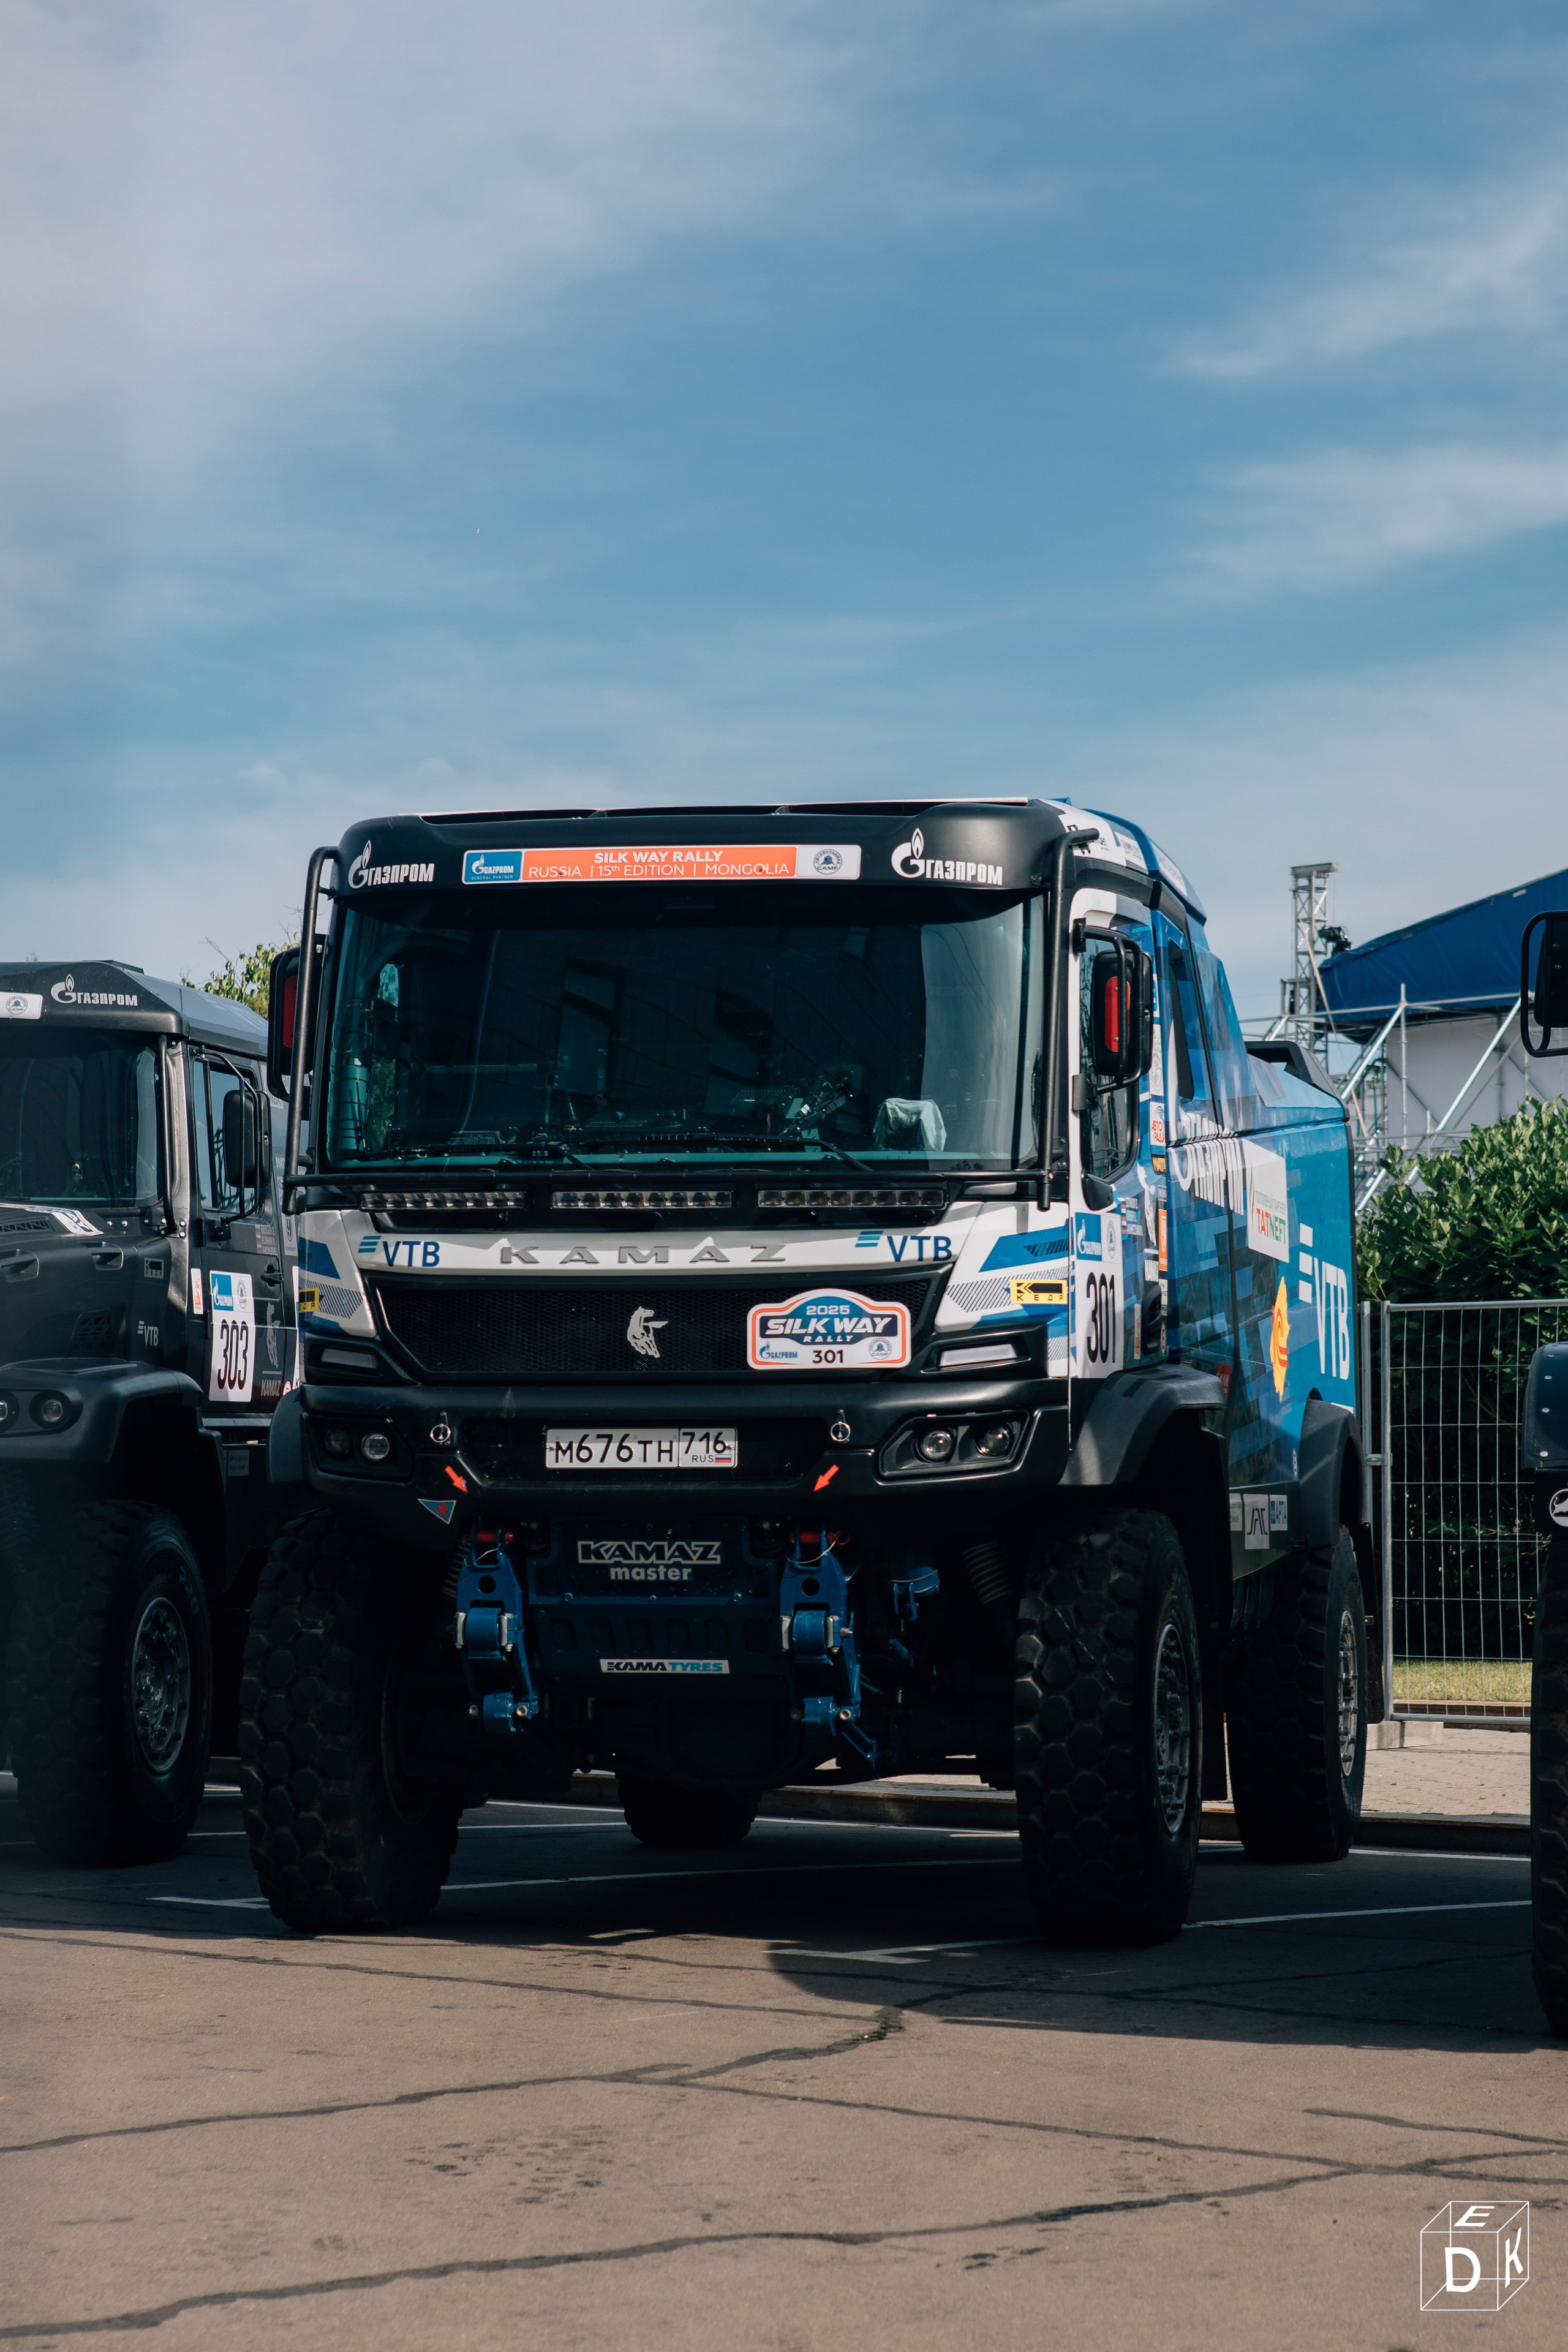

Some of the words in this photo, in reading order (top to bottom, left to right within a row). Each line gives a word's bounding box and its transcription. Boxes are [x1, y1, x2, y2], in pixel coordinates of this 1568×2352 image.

[594, 852, 629, 864] SILK
[633, 851, 669, 863] WAY
[673, 850, 723, 862] RALLY
[368, 863, 434, 886] ГАЗПРОМ
[484, 865, 514, 874] GAZPROM
[529, 865, 582, 878] RUSSIA
[598, 865, 619, 876] 15th
[624, 864, 685, 876] EDITION
[705, 863, 790, 875] MONGOLIA
[925, 859, 1003, 886] ГАЗПРОМ
[77, 992, 138, 1006] ГАЗПРОМ
[1256, 1207, 1286, 1245] TATNEFT
[382, 1240, 440, 1266] VTB
[500, 1245, 786, 1264] KAMAZ
[886, 1235, 952, 1262] VTB
[806, 1305, 850, 1316] 2025
[1086, 1272, 1115, 1363] 301
[1313, 1257, 1350, 1380] VTB
[144, 1325, 159, 1346] VTB
[765, 1317, 831, 1335] SILK
[834, 1317, 892, 1333] WAY
[217, 1319, 248, 1390] 303
[812, 1349, 844, 1363] 301
[261, 1379, 281, 1396] KAMAZ
[682, 1431, 727, 1454] 716
[578, 1540, 722, 1564] KAMAZ
[610, 1565, 692, 1581] master
